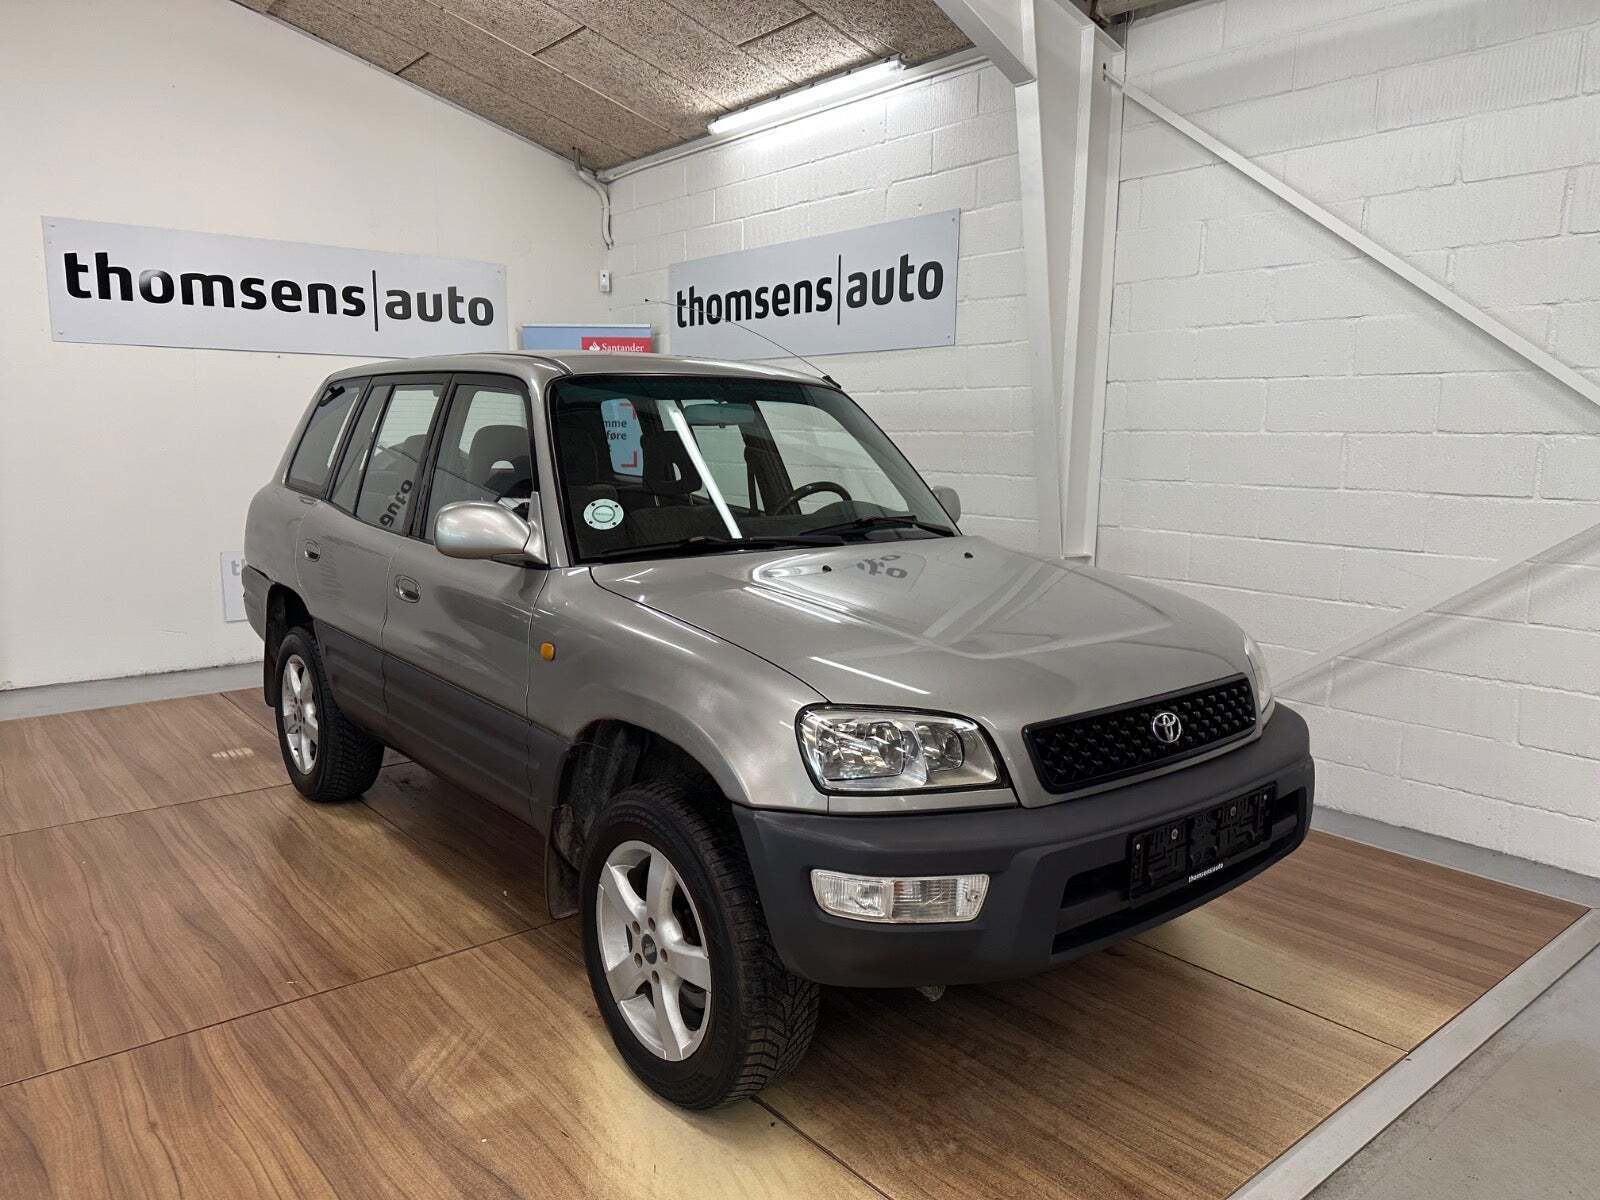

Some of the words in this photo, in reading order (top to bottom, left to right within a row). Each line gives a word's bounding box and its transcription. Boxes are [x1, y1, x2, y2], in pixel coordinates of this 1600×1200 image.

[63, 251, 366, 317] thomsens
[384, 285, 495, 326] auto
[676, 276, 833, 328] thomsens
[846, 253, 944, 309] auto
[601, 342, 645, 352] Santander
